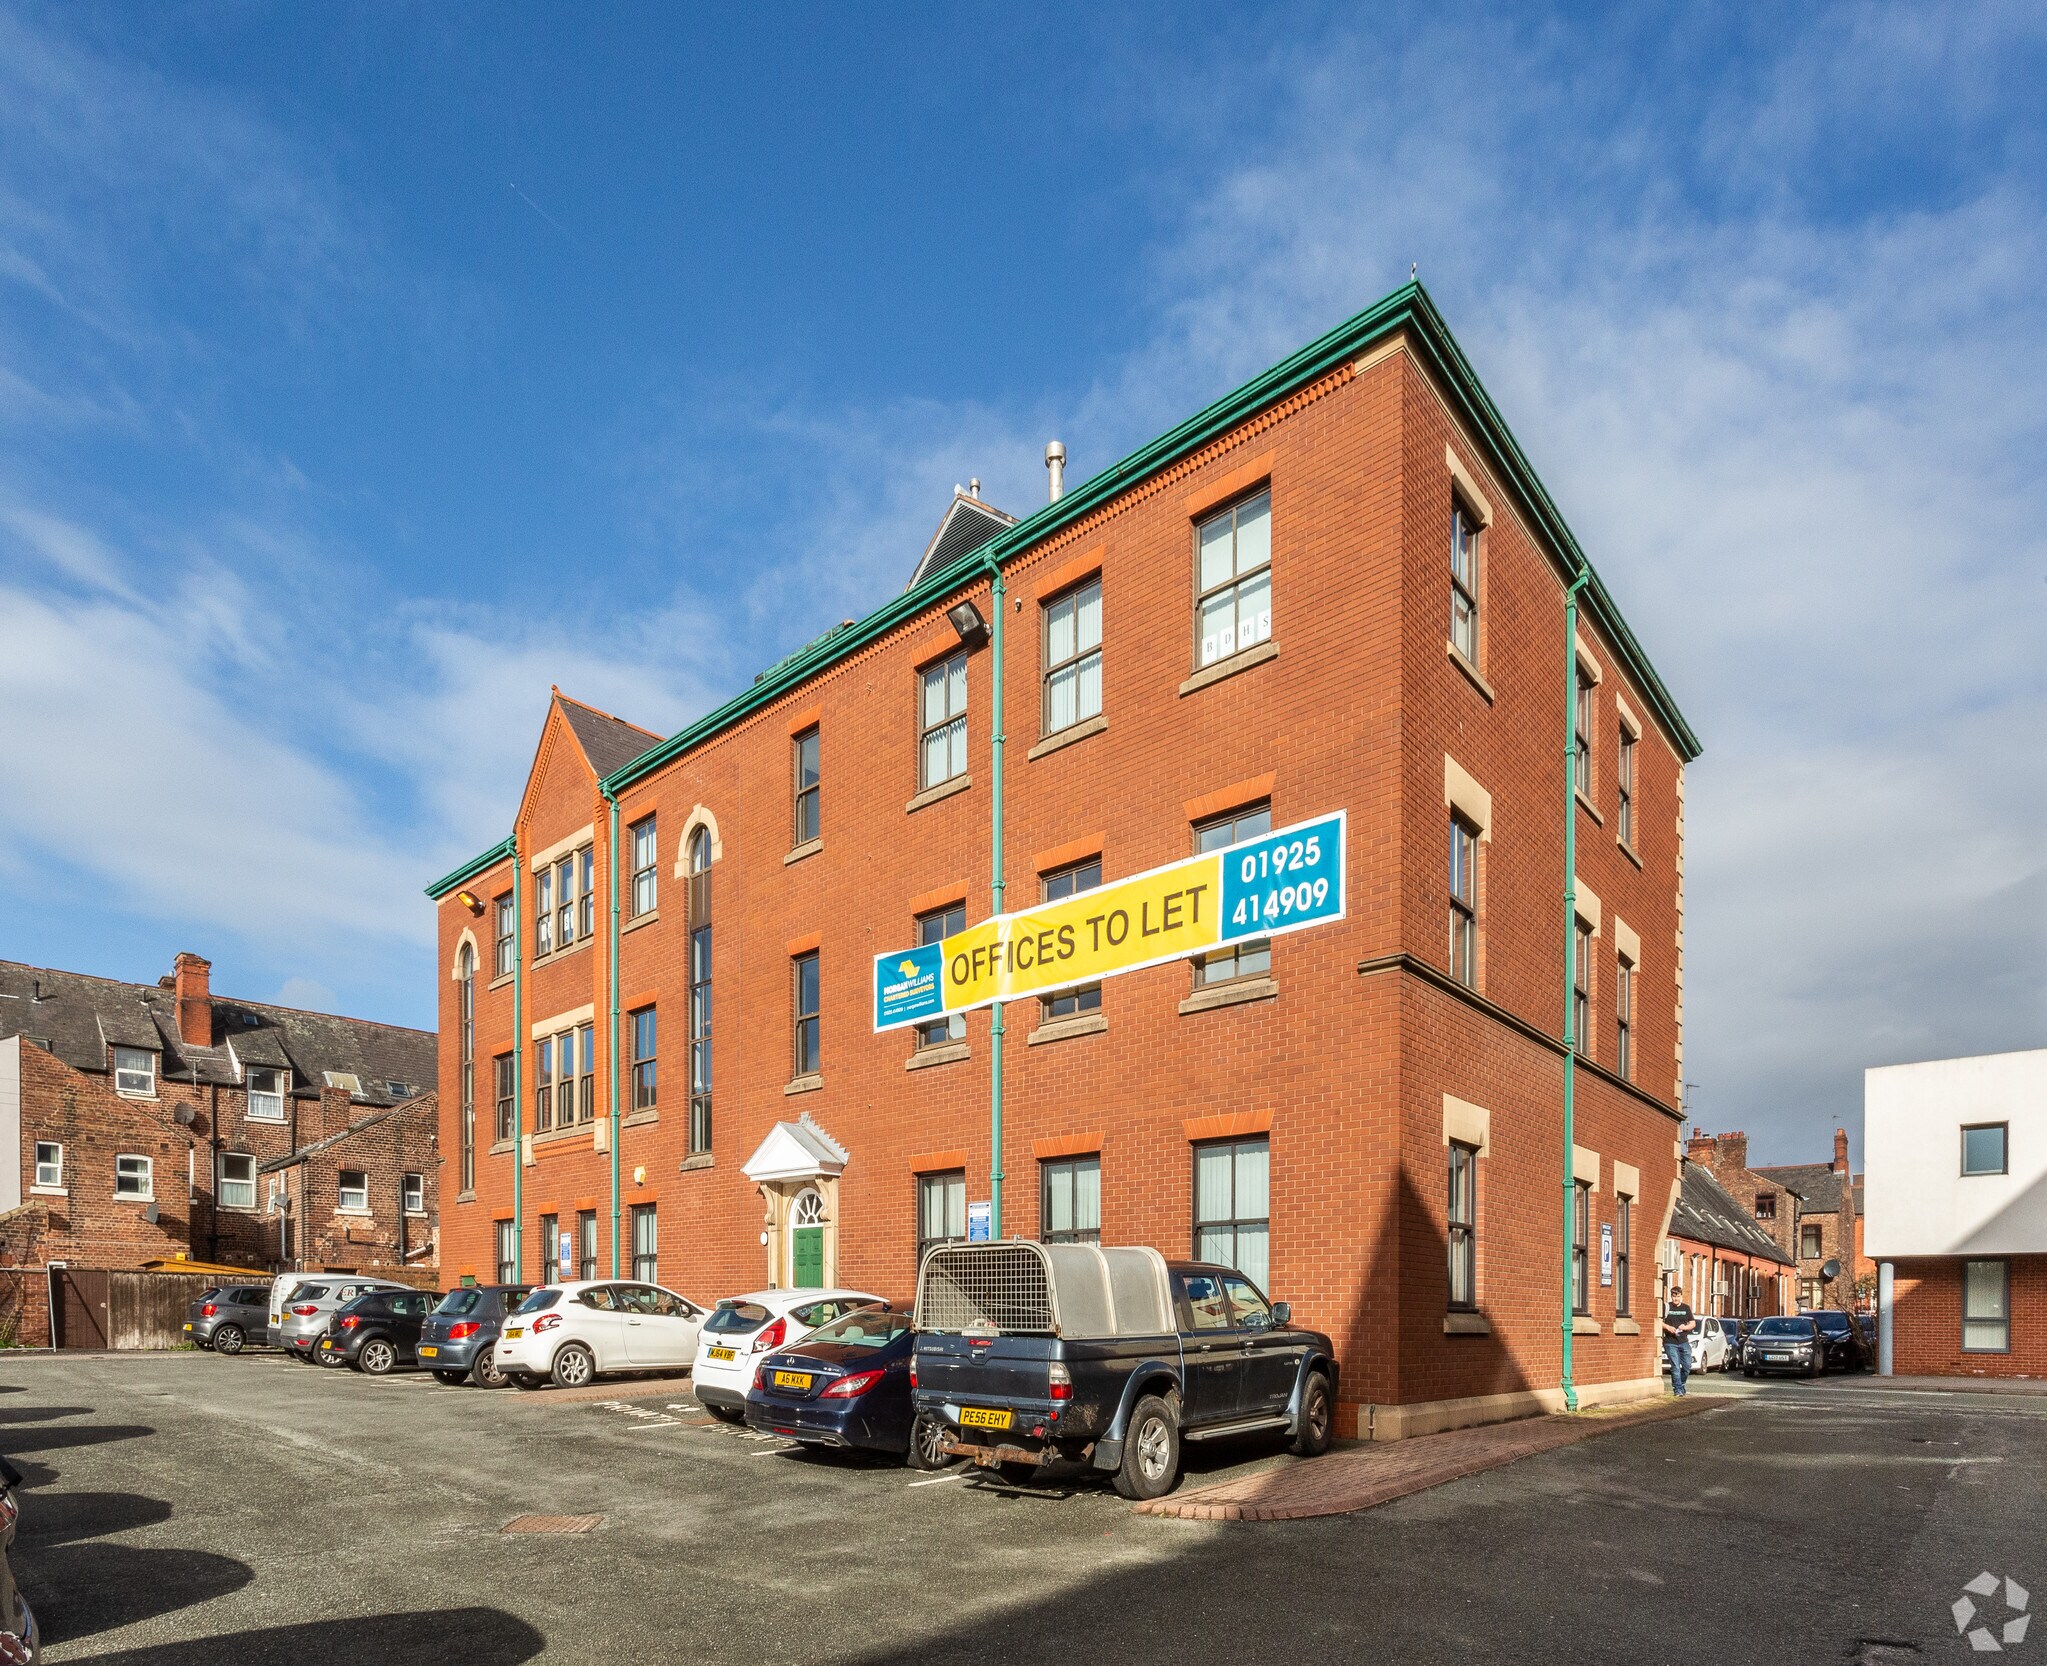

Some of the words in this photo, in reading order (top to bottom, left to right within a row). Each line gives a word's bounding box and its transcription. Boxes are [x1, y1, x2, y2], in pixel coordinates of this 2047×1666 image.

[1241, 835, 1321, 884] 01925
[1232, 877, 1329, 926] 414909
[951, 924, 1075, 986] OFFICES
[1086, 909, 1129, 952] TO
[1141, 884, 1208, 938] LET
[781, 1373, 790, 1384] A6
[790, 1374, 805, 1386] MXK
[963, 1410, 987, 1424] PE56
[987, 1412, 1007, 1426] EHY
